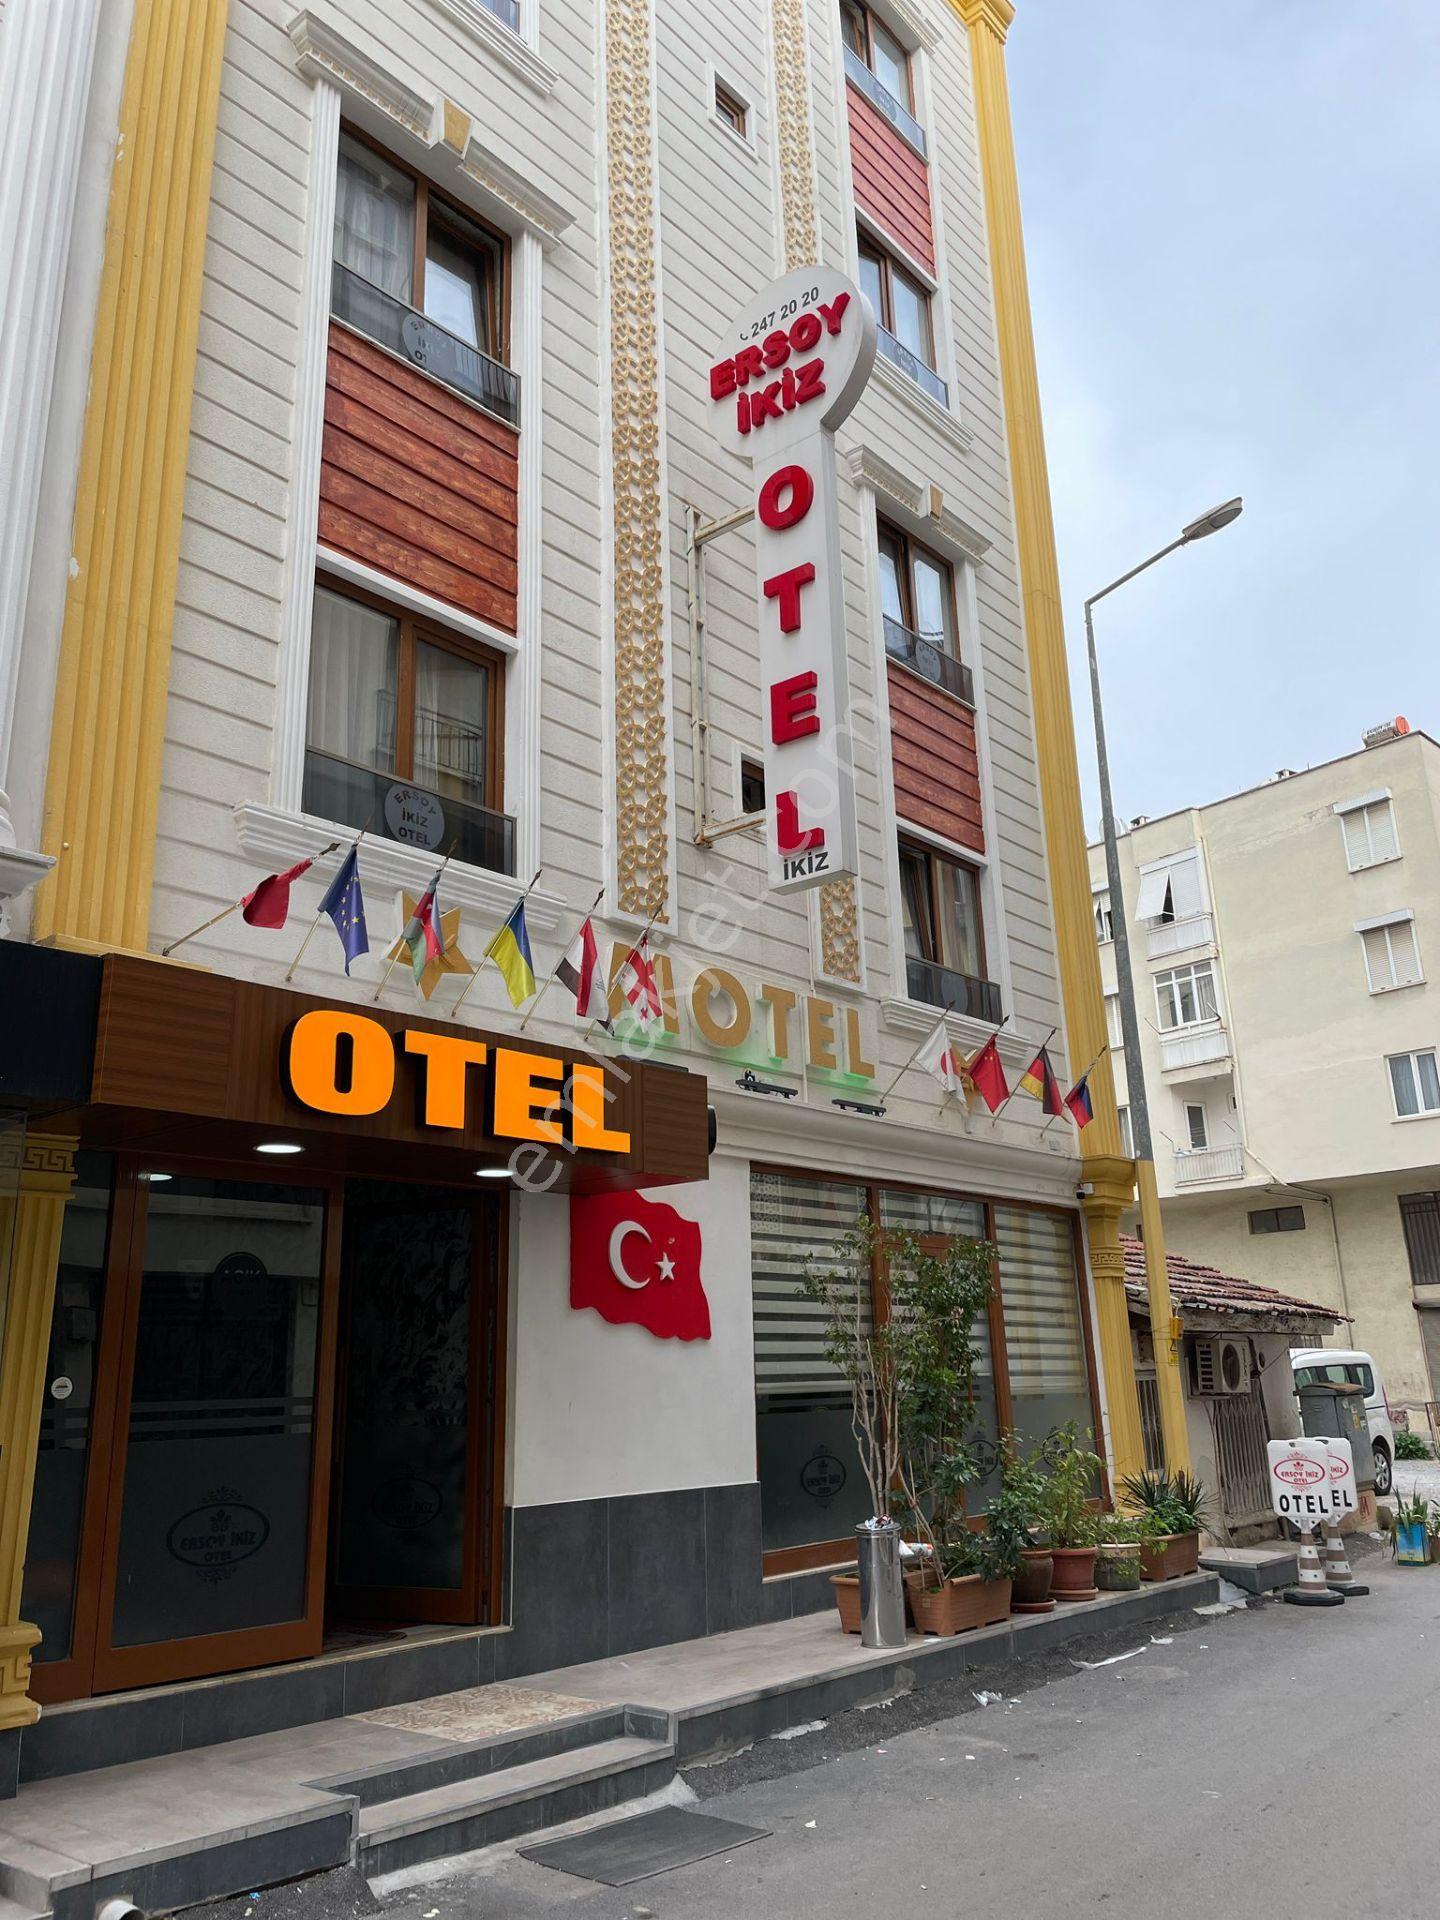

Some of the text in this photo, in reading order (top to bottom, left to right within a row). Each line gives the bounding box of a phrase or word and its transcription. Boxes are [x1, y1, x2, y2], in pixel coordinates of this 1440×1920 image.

[752, 287, 819, 338] 247 20 20
[710, 292, 851, 401] ERSOY
[736, 358, 826, 435] İKİZ
[758, 464, 825, 856] OTEL
[394, 790, 437, 815] ERSOY
[399, 826, 430, 846] OTEL
[783, 851, 829, 880] İKİZ
[289, 1010, 630, 1153] OTEL
[1279, 1494, 1328, 1513] OTEL
